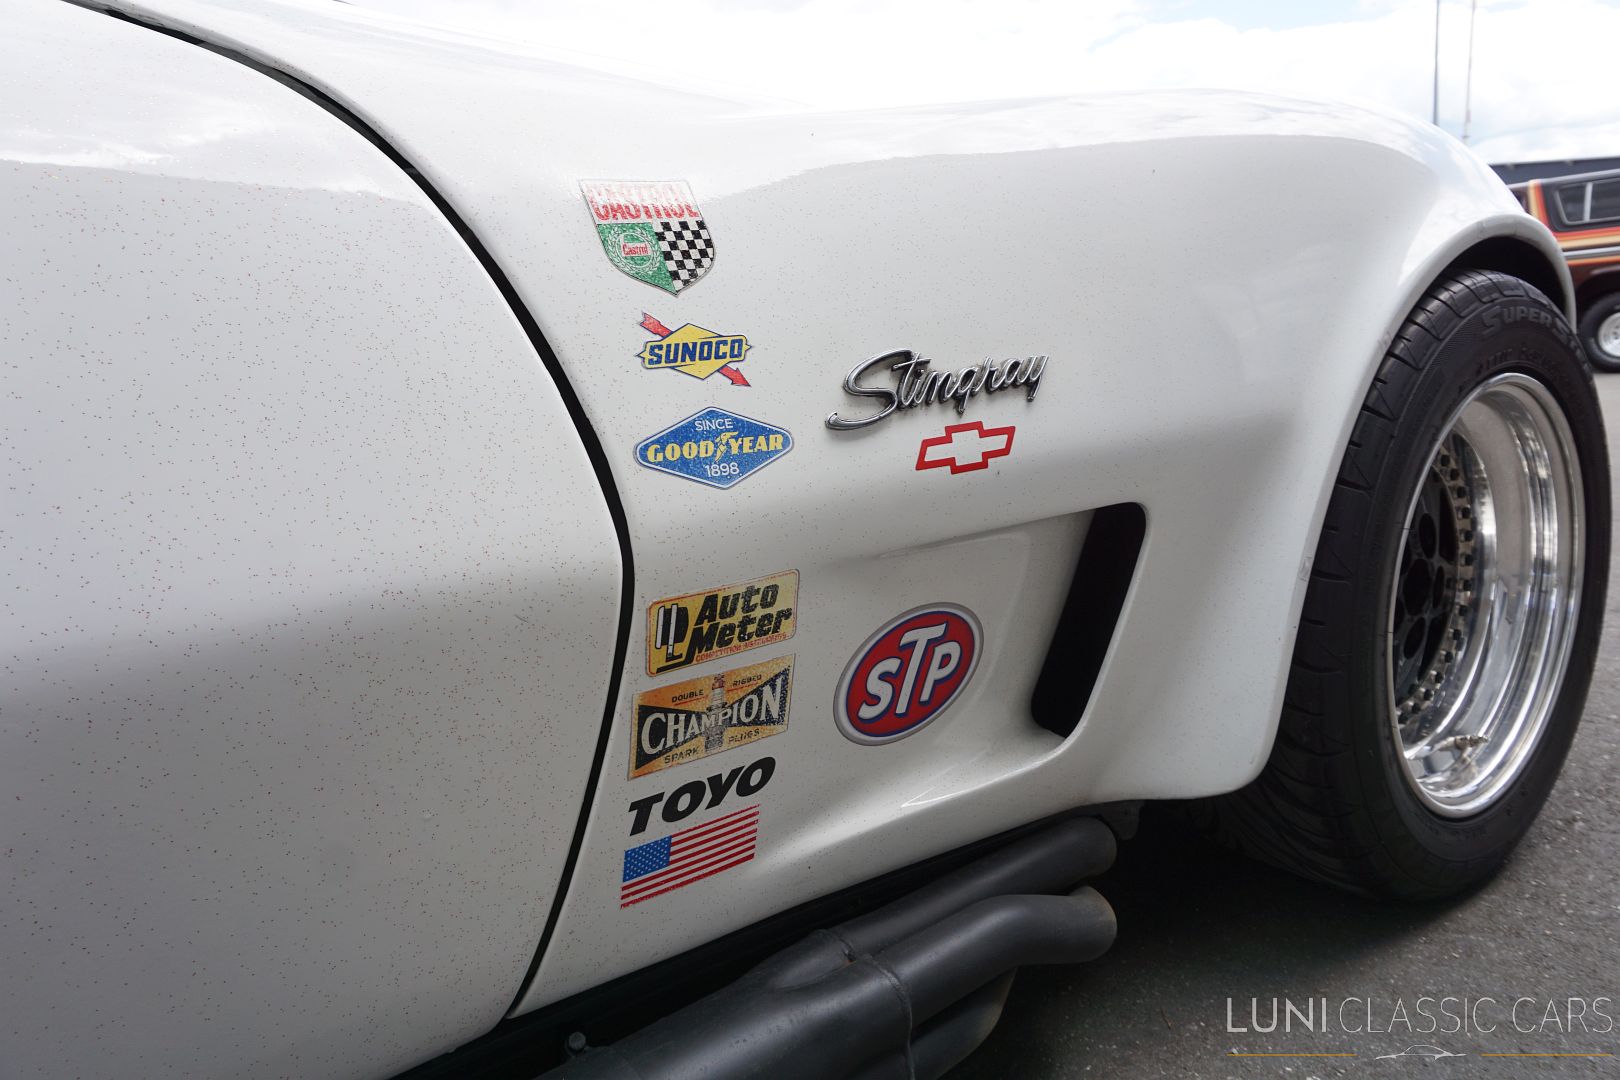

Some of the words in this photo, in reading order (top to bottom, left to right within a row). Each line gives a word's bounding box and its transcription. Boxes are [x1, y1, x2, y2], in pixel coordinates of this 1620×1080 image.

[648, 338, 743, 365] SUNOCO
[825, 349, 1049, 431] Stingray
[695, 418, 734, 431] SINCE
[705, 462, 739, 477] 1898
[694, 584, 779, 626] Auto
[686, 607, 792, 654] Meter
[858, 623, 961, 720] STP
[641, 676, 786, 755] CHAMPION
[672, 689, 704, 703] DOUBLE
[664, 746, 700, 764] SPARK
[628, 757, 776, 836] TOYO
